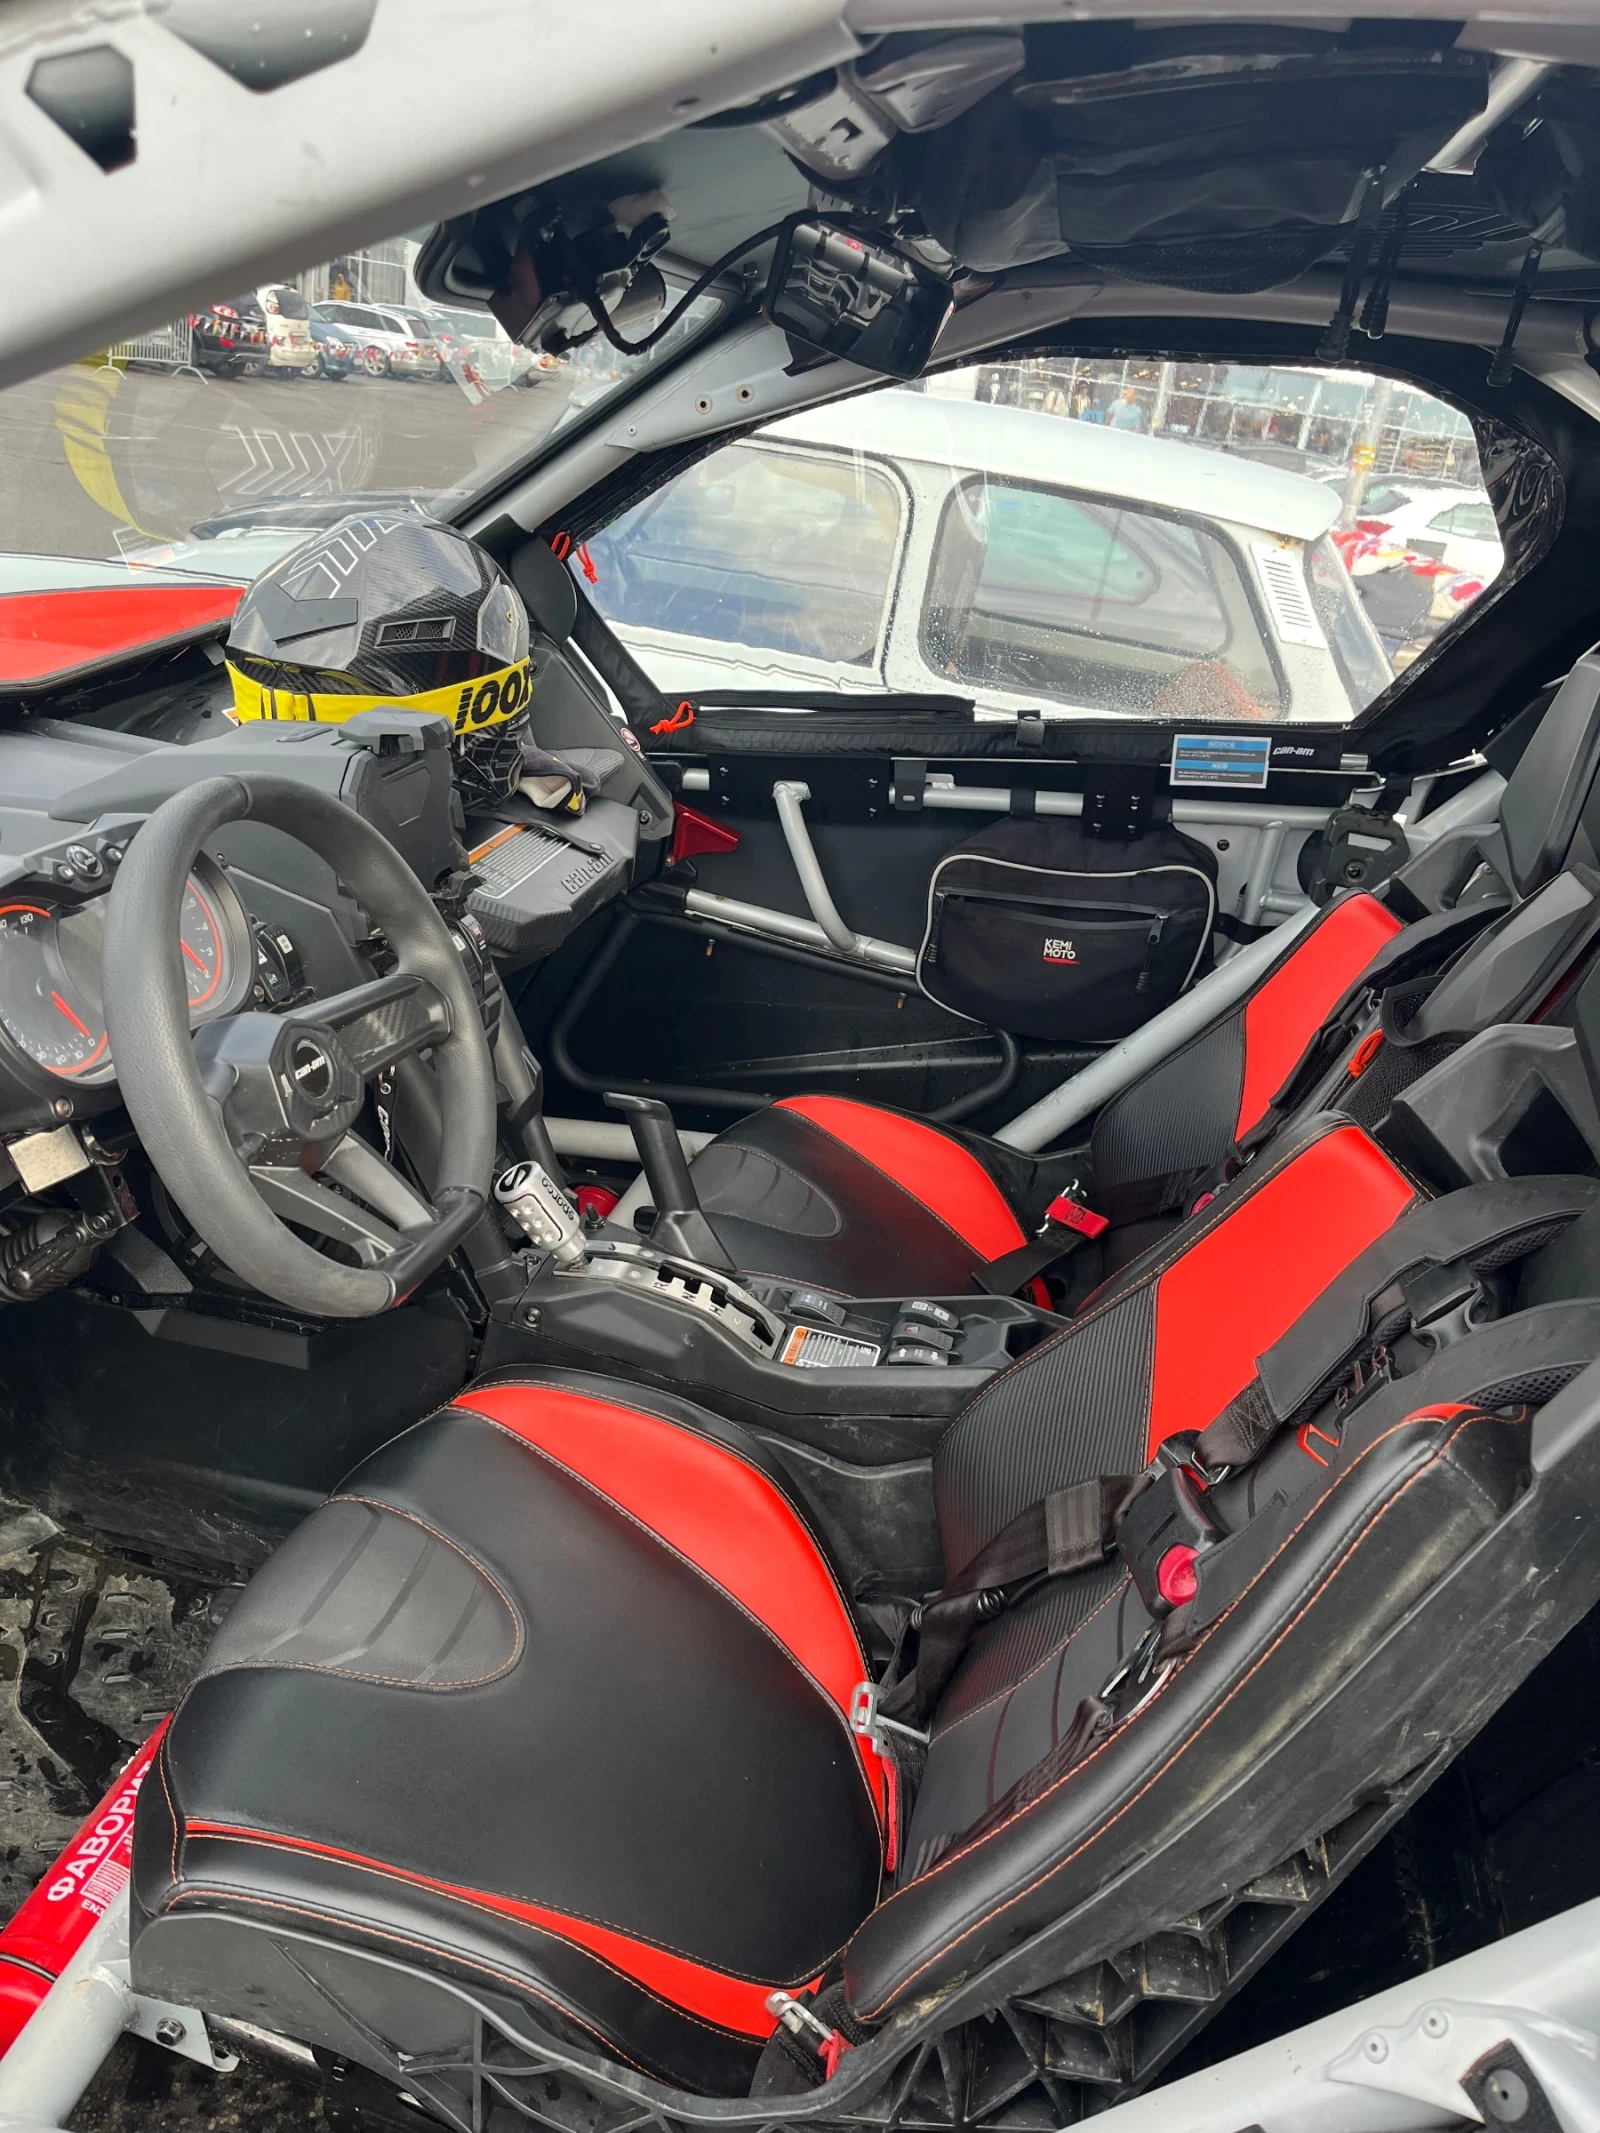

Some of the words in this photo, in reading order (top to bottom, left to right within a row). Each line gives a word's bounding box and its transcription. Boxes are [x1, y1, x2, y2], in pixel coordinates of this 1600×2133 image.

[1207, 741, 1236, 749] NOTICE
[1272, 746, 1315, 757] can-am
[1211, 762, 1229, 770] AVIS
[20, 912, 34, 925] 130
[202, 922, 209, 931] 4
[1044, 938, 1073, 951] KEMI
[206, 946, 214, 957] 3
[1043, 948, 1077, 960] MOTO
[87, 1038, 96, 1047] 0
[36, 1050, 47, 1061] 30
[55, 1054, 67, 1066] 20
[74, 1049, 84, 1060] 10
[294, 1055, 326, 1081] can-am
[541, 1177, 576, 1221] sparco
